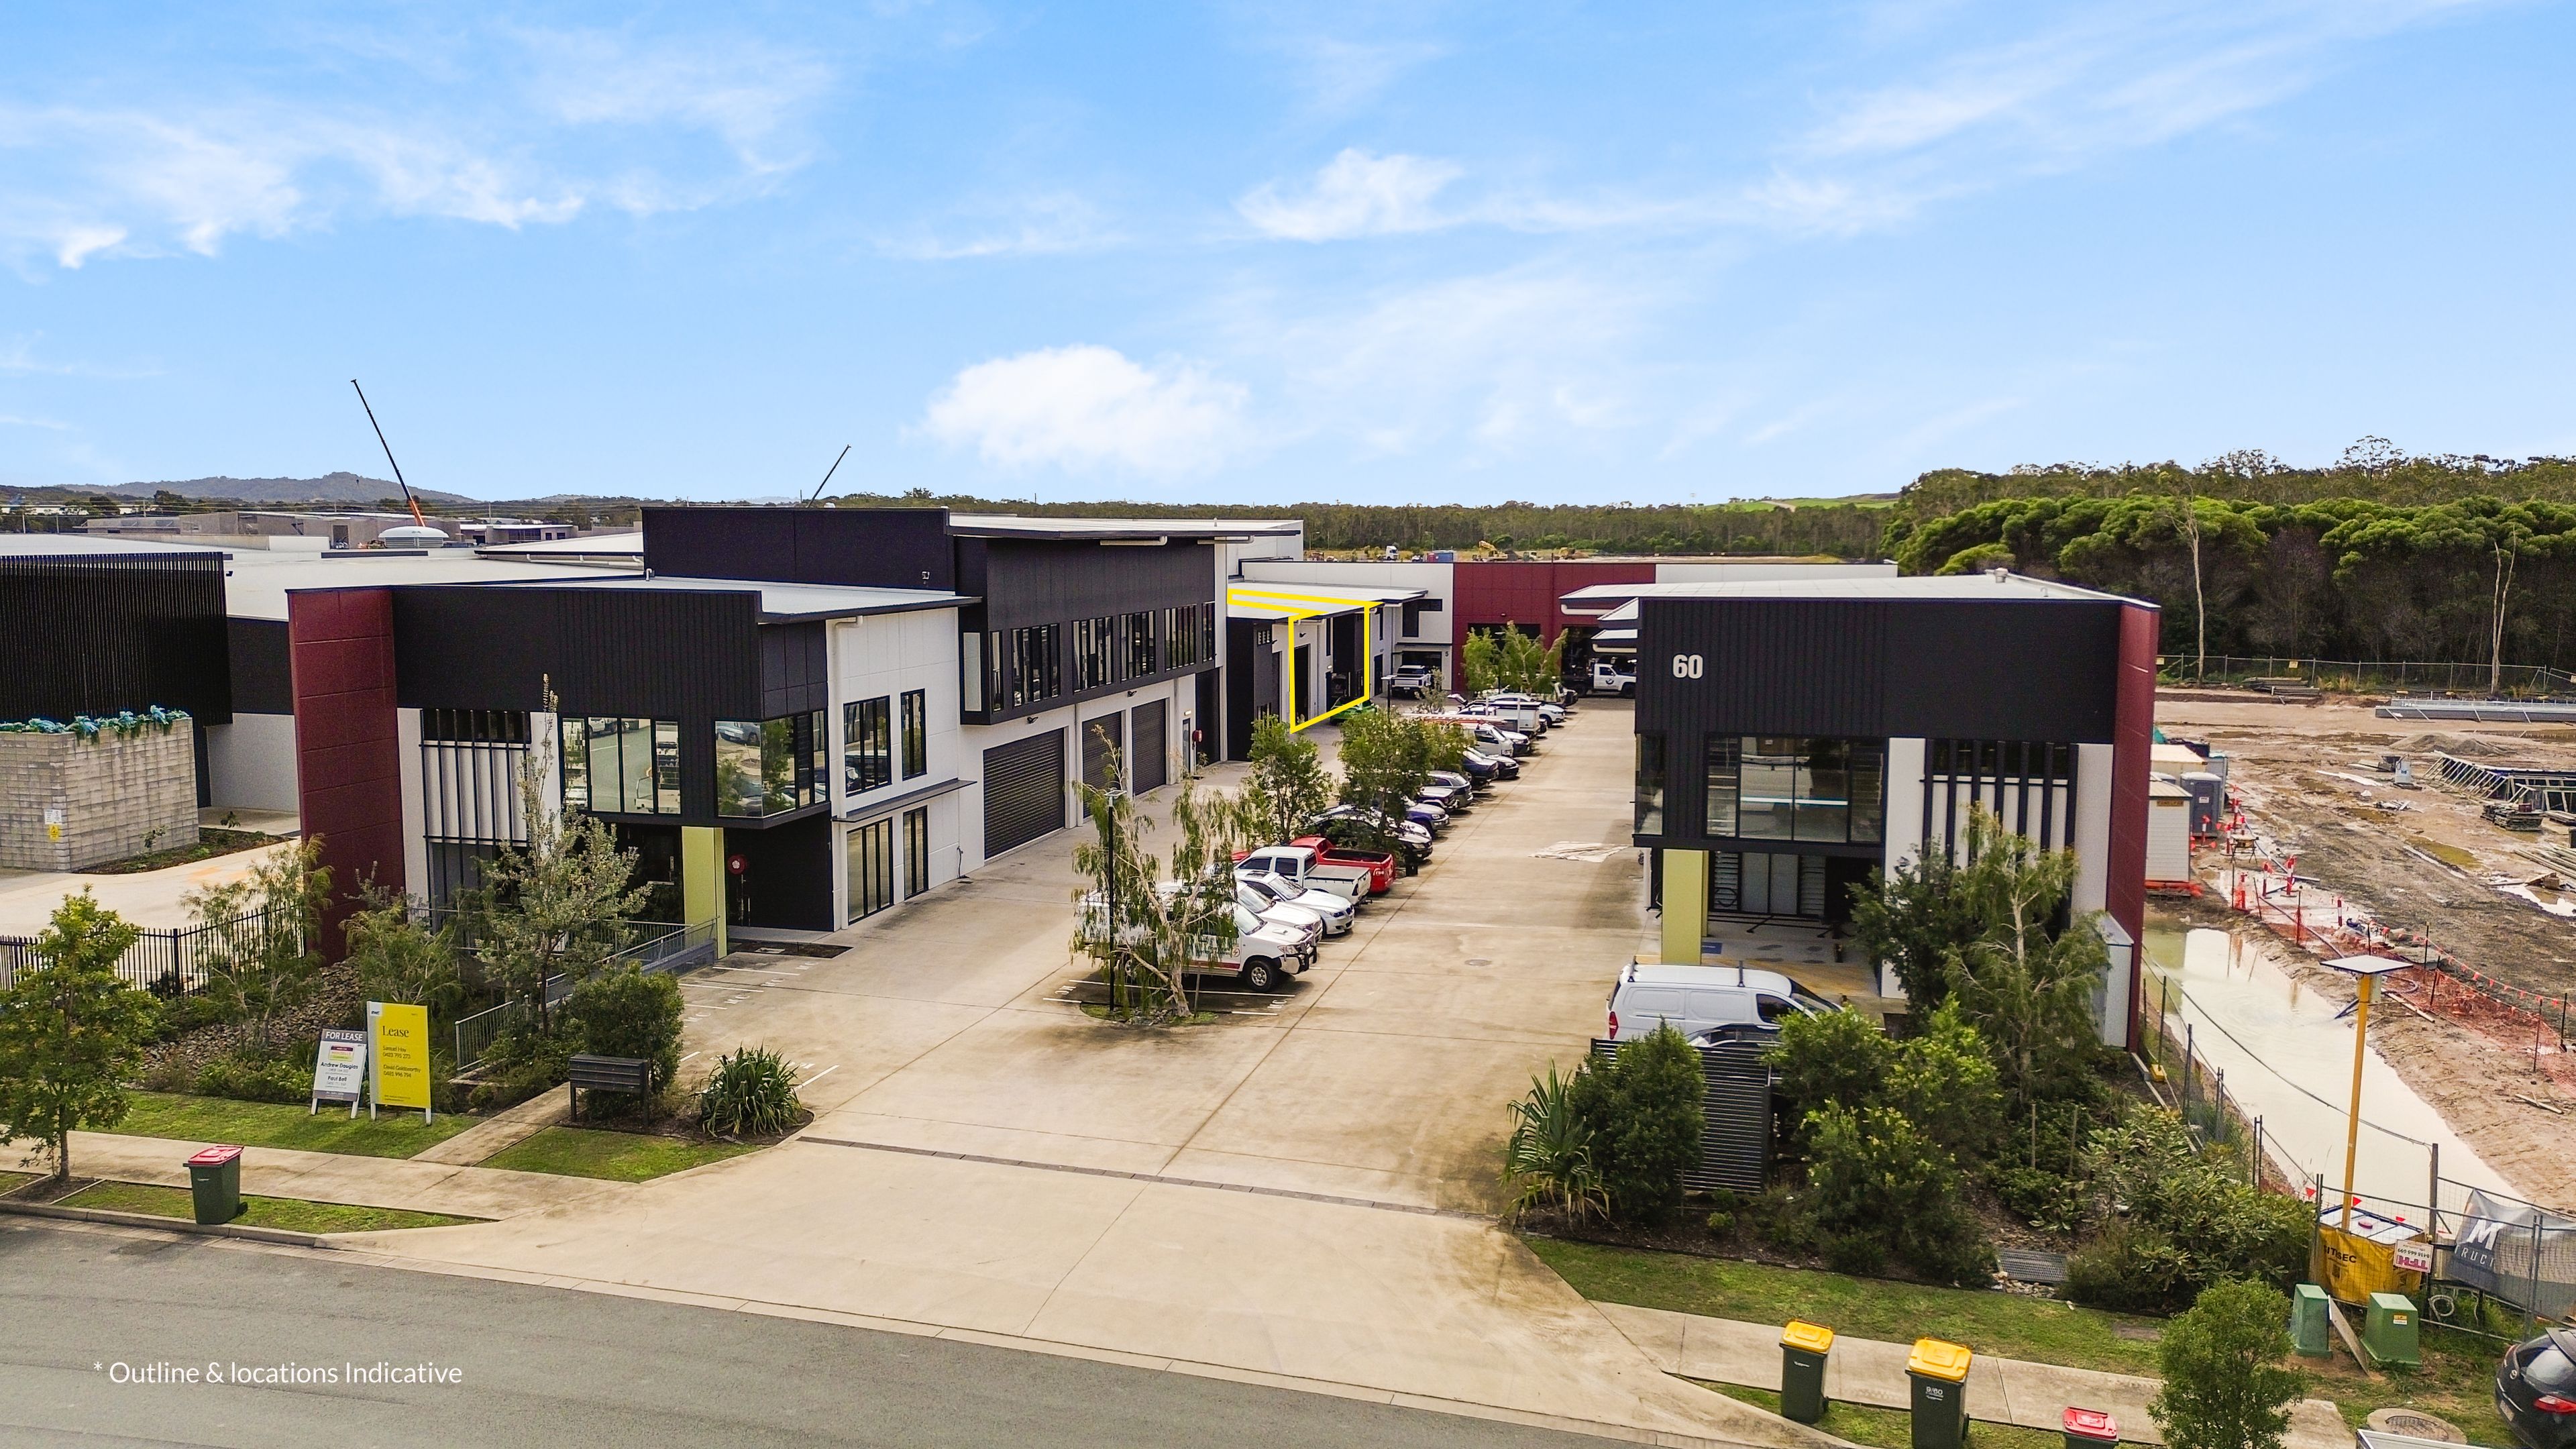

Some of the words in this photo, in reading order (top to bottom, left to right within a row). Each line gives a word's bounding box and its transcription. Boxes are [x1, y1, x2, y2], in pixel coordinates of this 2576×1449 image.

[1672, 654, 1703, 679] 60
[325, 1031, 340, 1040] FOR
[341, 1032, 363, 1041] LEASE
[382, 1025, 409, 1038] Lease
[2466, 1216, 2507, 1250] M
